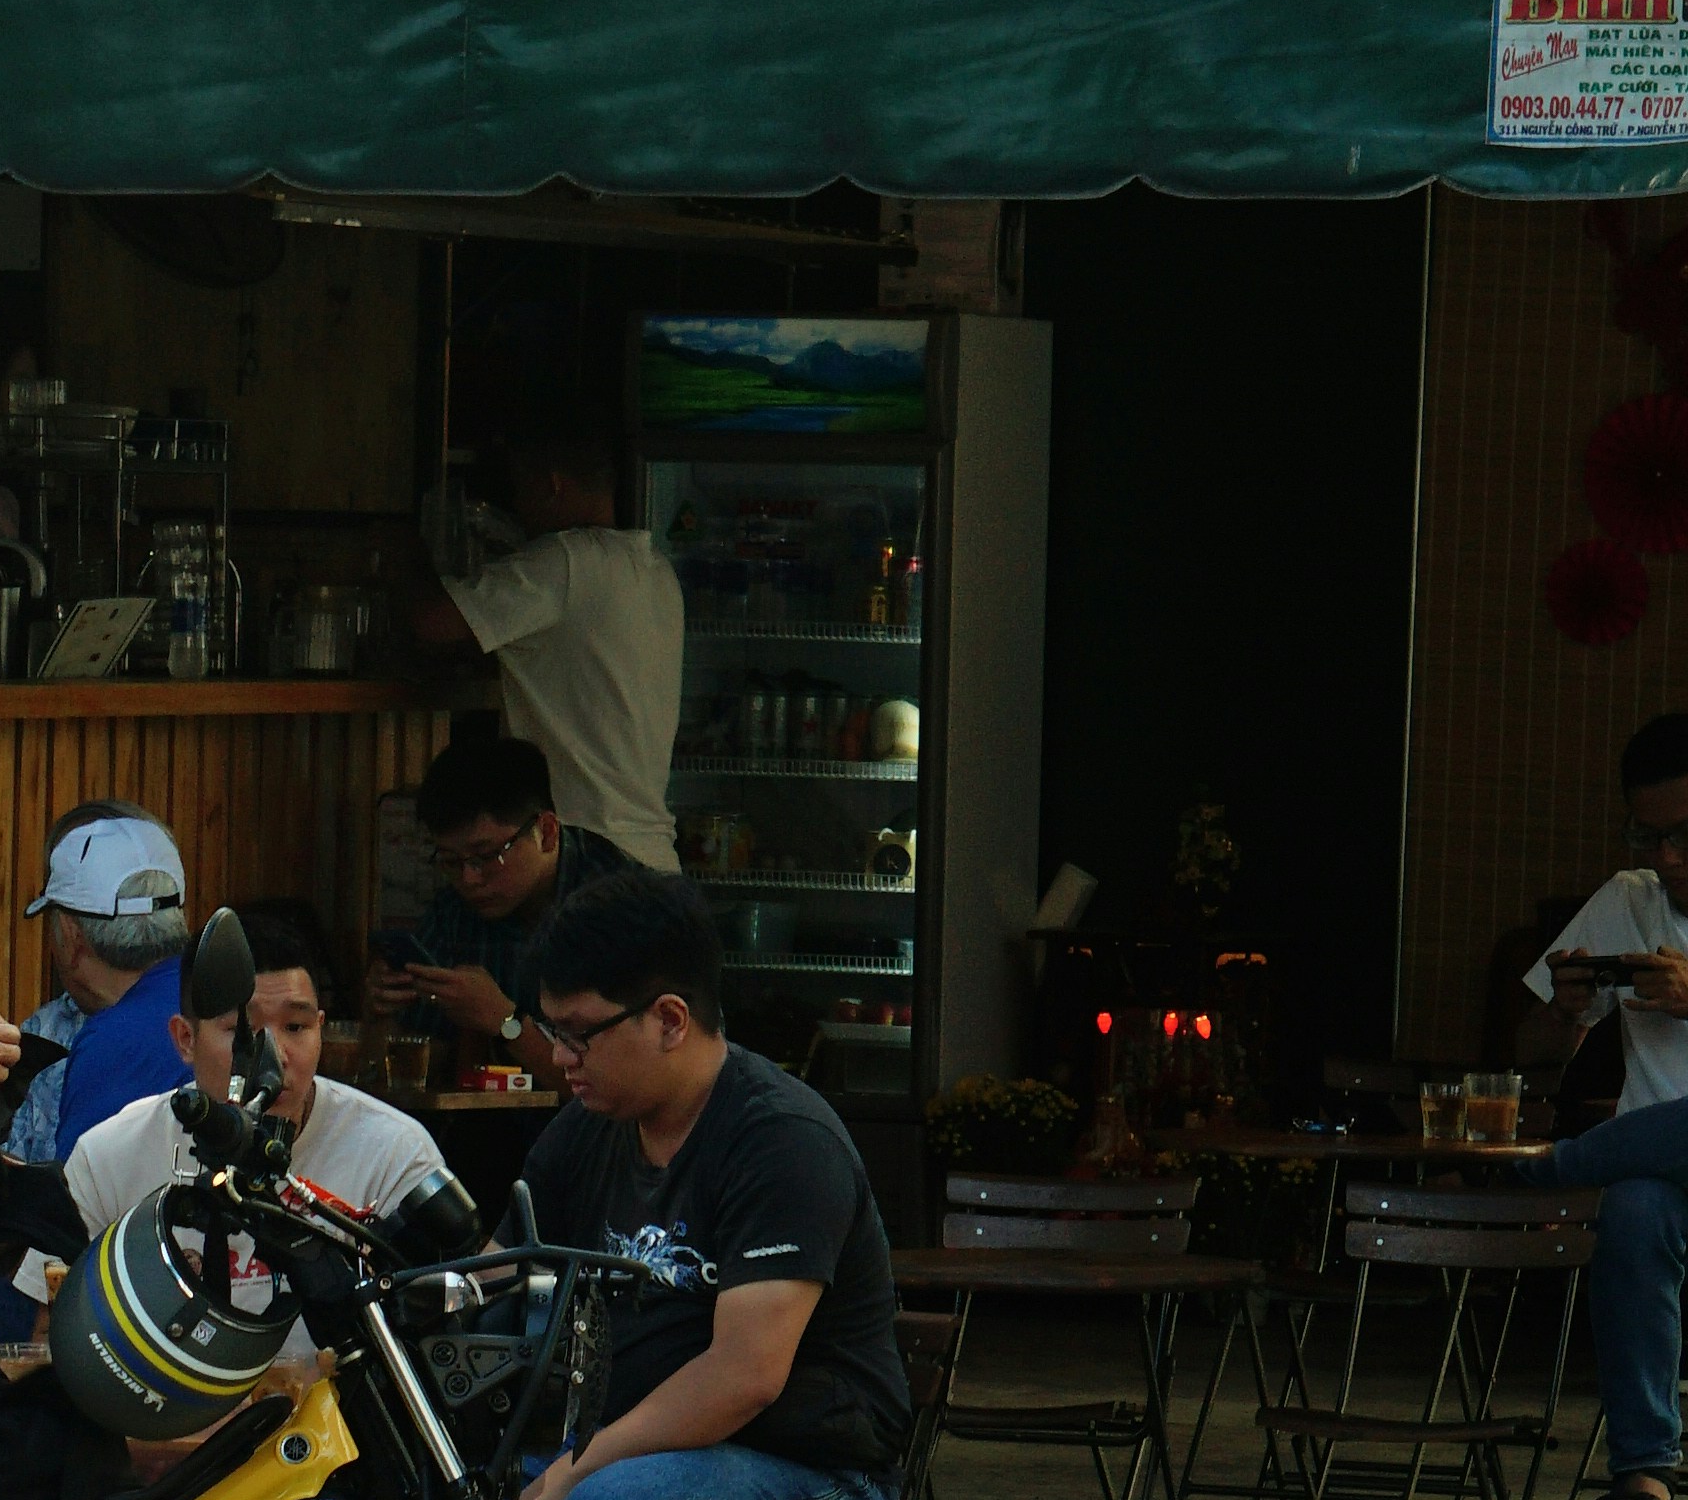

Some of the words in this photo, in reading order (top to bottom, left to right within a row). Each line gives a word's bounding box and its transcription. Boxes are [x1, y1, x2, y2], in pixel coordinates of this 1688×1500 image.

[1589, 29, 1622, 42] BẠT
[1546, 31, 1578, 59] May
[1585, 44, 1617, 57] MÁI
[1623, 44, 1664, 57] HIÊN
[1611, 62, 1644, 75] CÁC
[1579, 82, 1613, 94] RẠP
[1501, 96, 1624, 119] 0903.00.44.77
[1499, 124, 1517, 135] 311
[1521, 120, 1562, 136] NGUYỄN
[1565, 122, 1593, 136] CÔNG
[89, 1332, 144, 1394] MICHELIN
